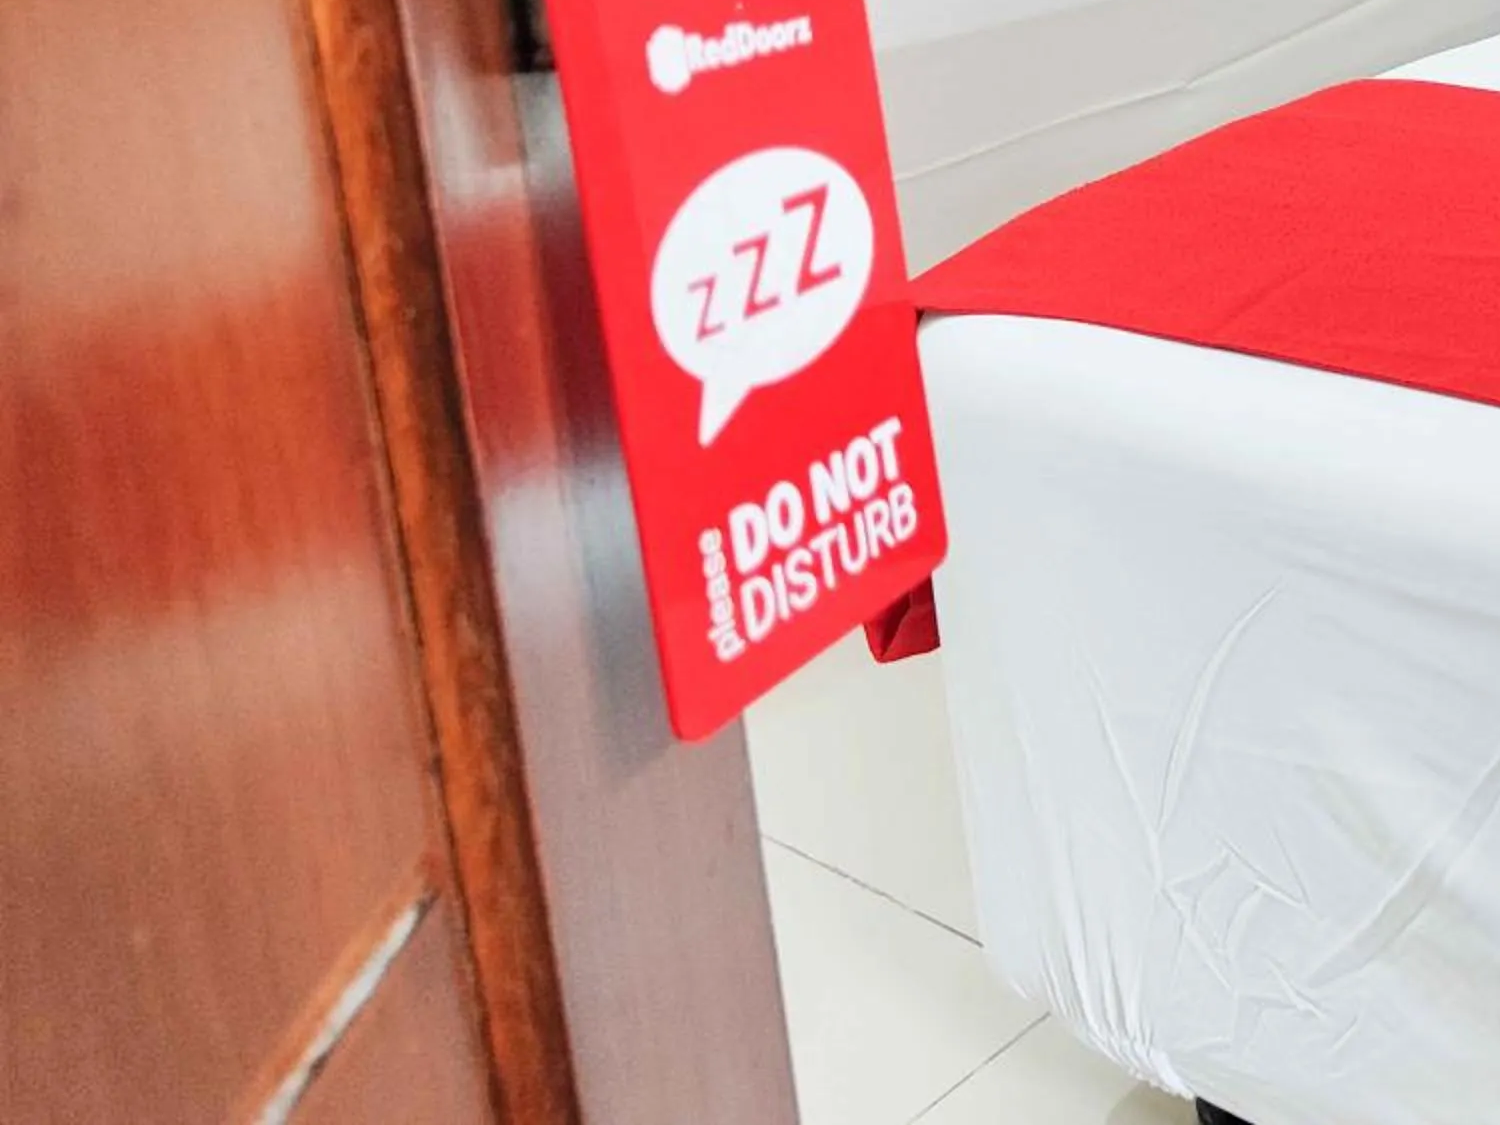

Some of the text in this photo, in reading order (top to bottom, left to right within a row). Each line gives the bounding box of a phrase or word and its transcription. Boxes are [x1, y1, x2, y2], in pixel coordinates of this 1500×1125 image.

[685, 15, 813, 74] RedDoorz
[729, 417, 904, 575] DO NOT
[740, 483, 918, 644] DISTURB
[698, 528, 746, 664] please
